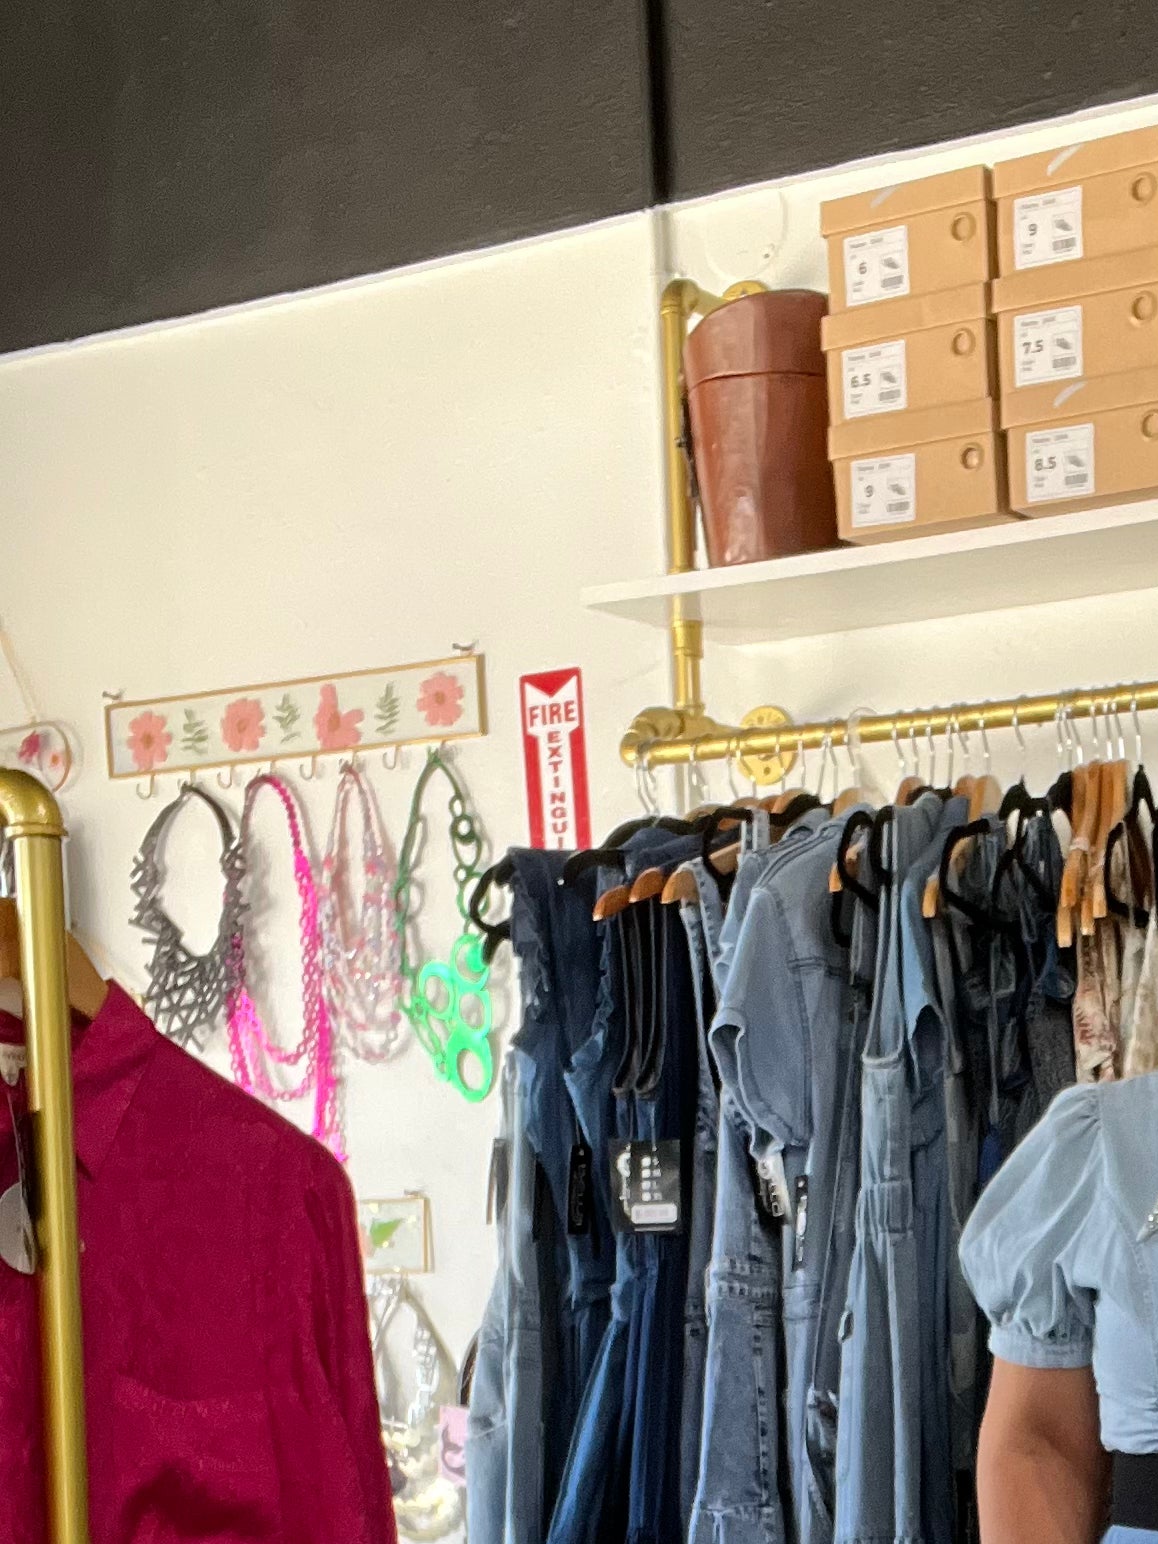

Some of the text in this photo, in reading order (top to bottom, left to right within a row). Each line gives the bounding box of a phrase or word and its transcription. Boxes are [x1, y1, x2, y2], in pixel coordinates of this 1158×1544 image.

[1027, 223, 1038, 237] 9
[858, 261, 868, 275] 6
[1021, 339, 1044, 355] 7.5
[529, 700, 576, 728] FIRE
